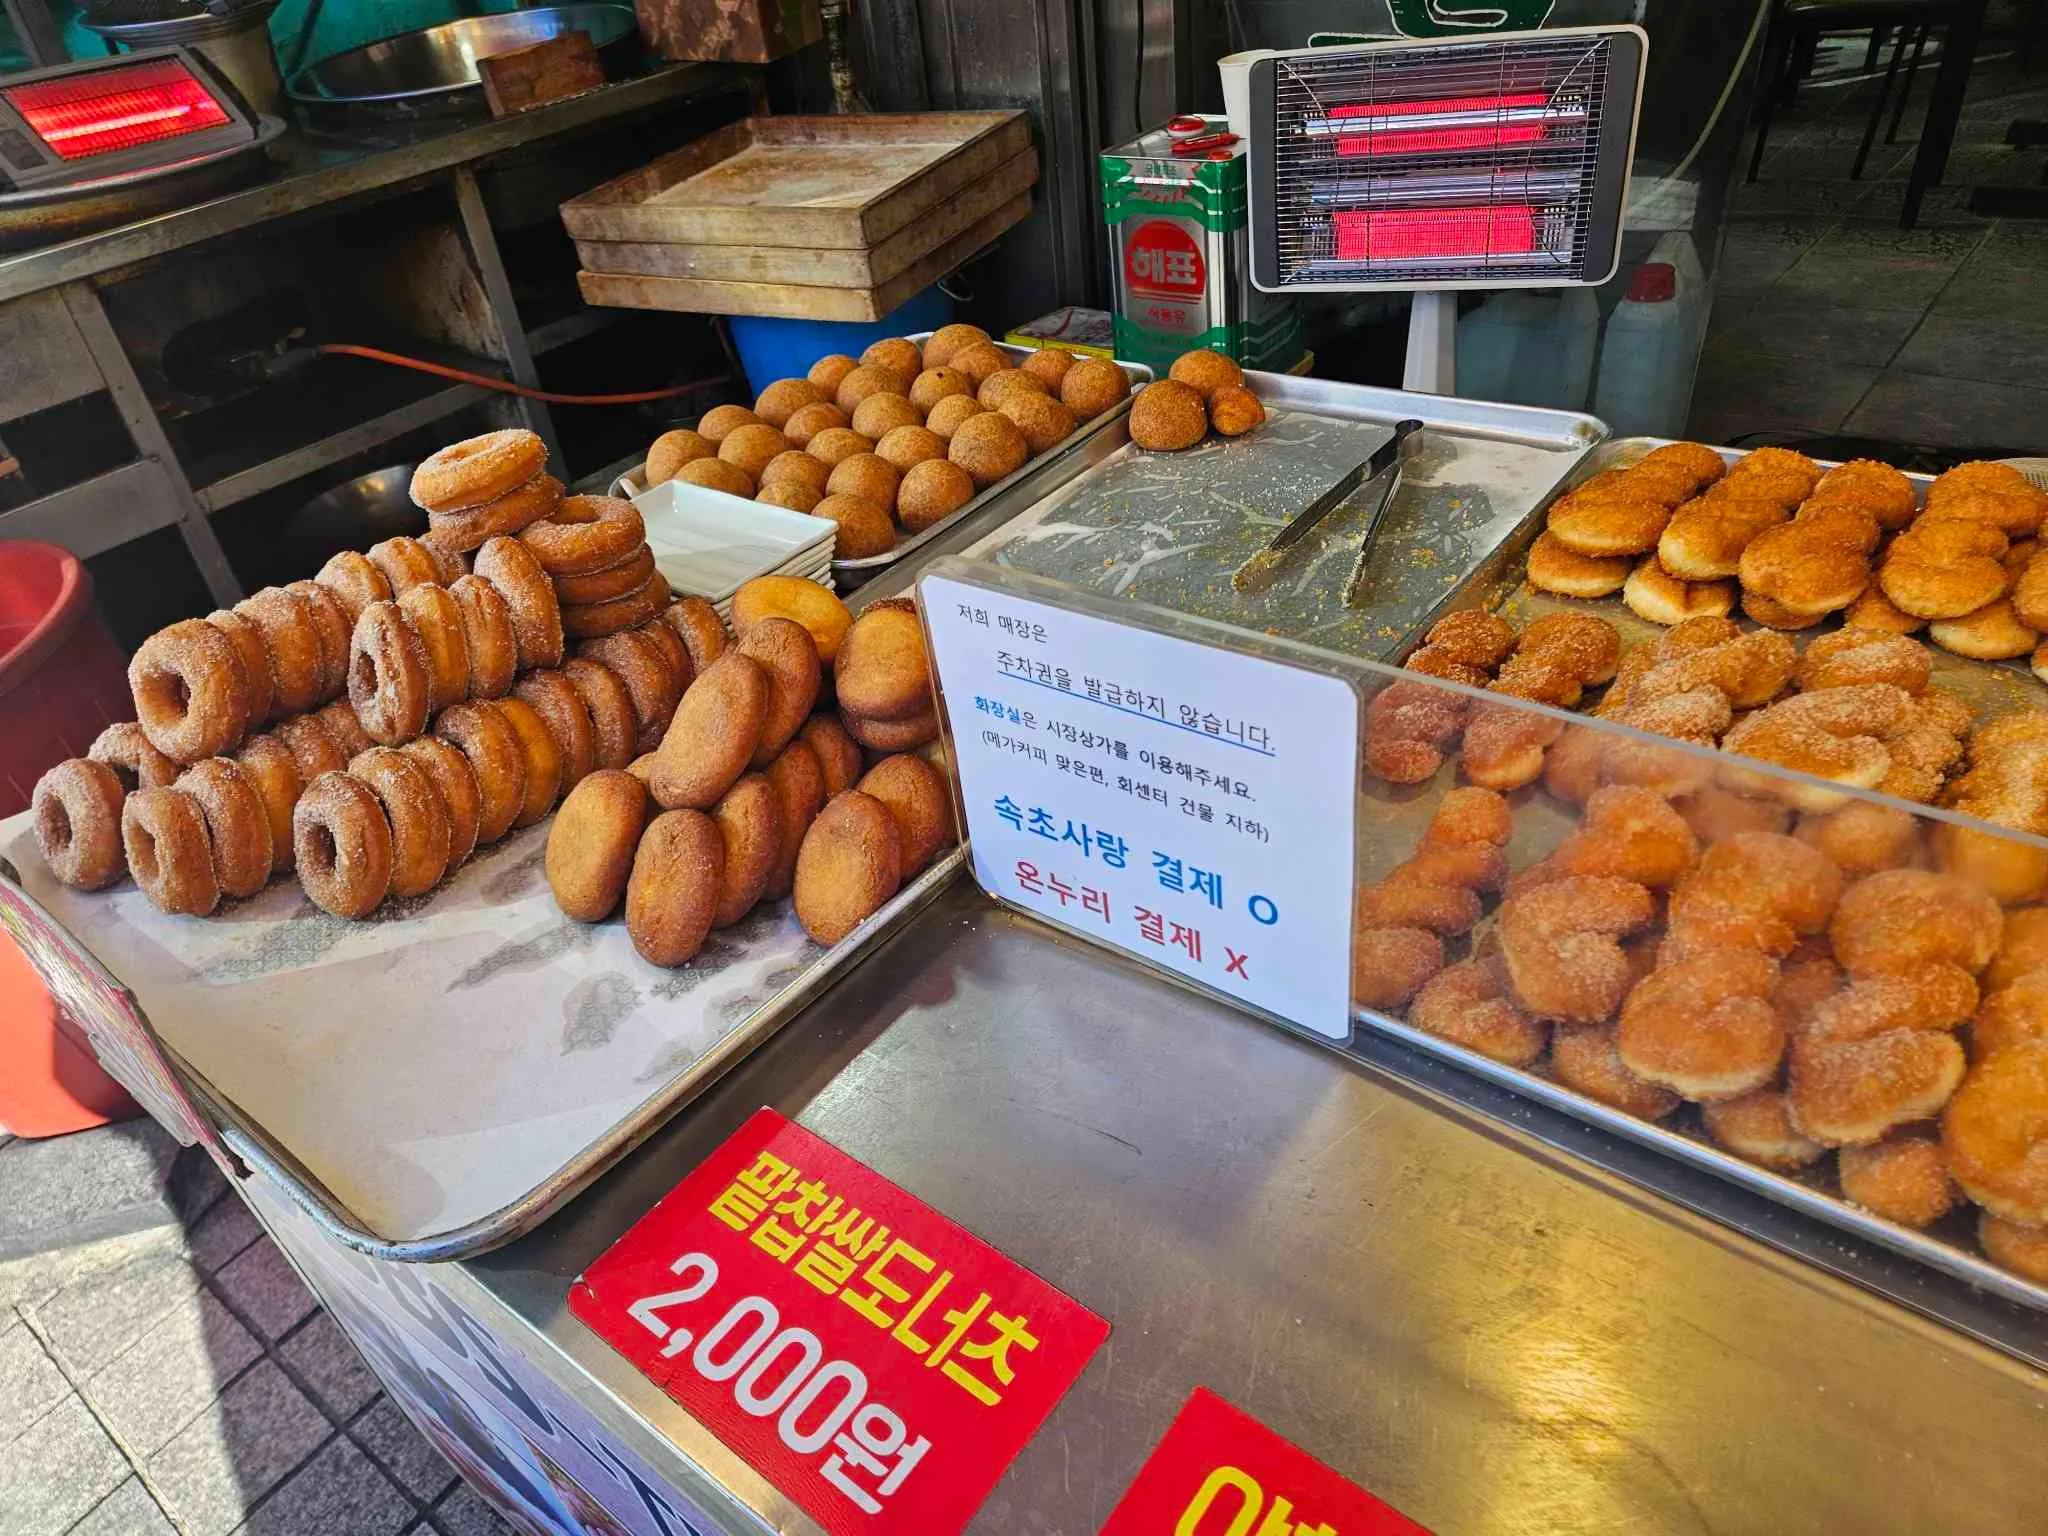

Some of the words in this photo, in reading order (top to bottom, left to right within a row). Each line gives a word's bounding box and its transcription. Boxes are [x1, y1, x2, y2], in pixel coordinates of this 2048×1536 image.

[1133, 247, 1197, 286] 해표
[957, 604, 990, 627] 저희
[998, 614, 1048, 644] 매장은
[974, 695, 1038, 730] 화장실은
[1046, 720, 1129, 760] 시장상가를
[1139, 748, 1256, 802] 이용해주세요.
[996, 650, 1072, 691] 주차권을
[1083, 674, 1167, 719] 발급하지
[1179, 705, 1276, 752] 않습니다.
[981, 730, 1048, 765] (메가커피
[1117, 776, 1168, 807] 회센터
[1179, 796, 1214, 822] 건물
[1225, 812, 1269, 843] 지하)
[994, 794, 1129, 869] 속초사랑
[1152, 849, 1223, 908] 결제
[1014, 860, 1111, 923] 온누리
[1134, 906, 1202, 962] 결제
[708, 1150, 1039, 1406] 팥찹쌀도너츠
[627, 1252, 932, 1514] 2,000원
